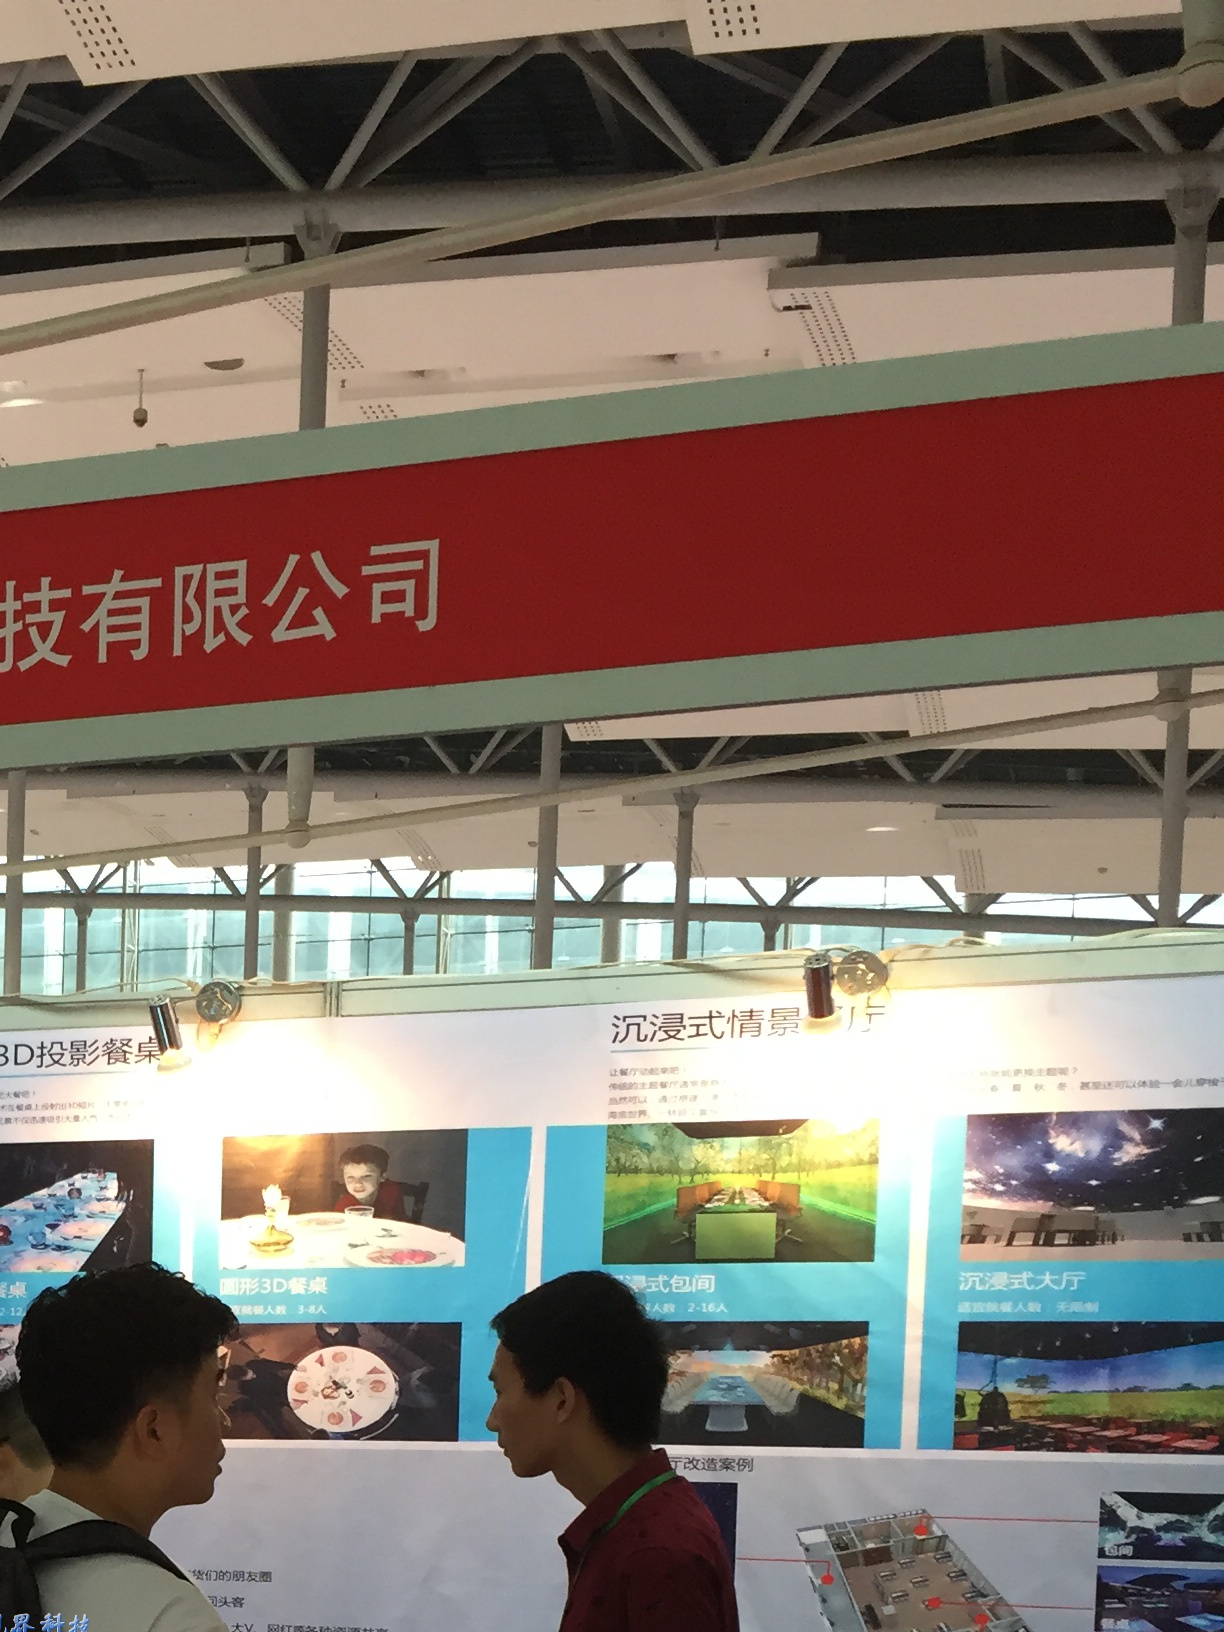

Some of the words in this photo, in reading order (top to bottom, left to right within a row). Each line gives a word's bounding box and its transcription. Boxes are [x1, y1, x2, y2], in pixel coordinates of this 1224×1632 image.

[611, 1005, 885, 1044] 沉浸式情景厅
[219, 1276, 328, 1296] 圆形3D餐桌
[612, 1273, 716, 1294] 浸式包间
[959, 1270, 1087, 1291] 沉浸式大厅
